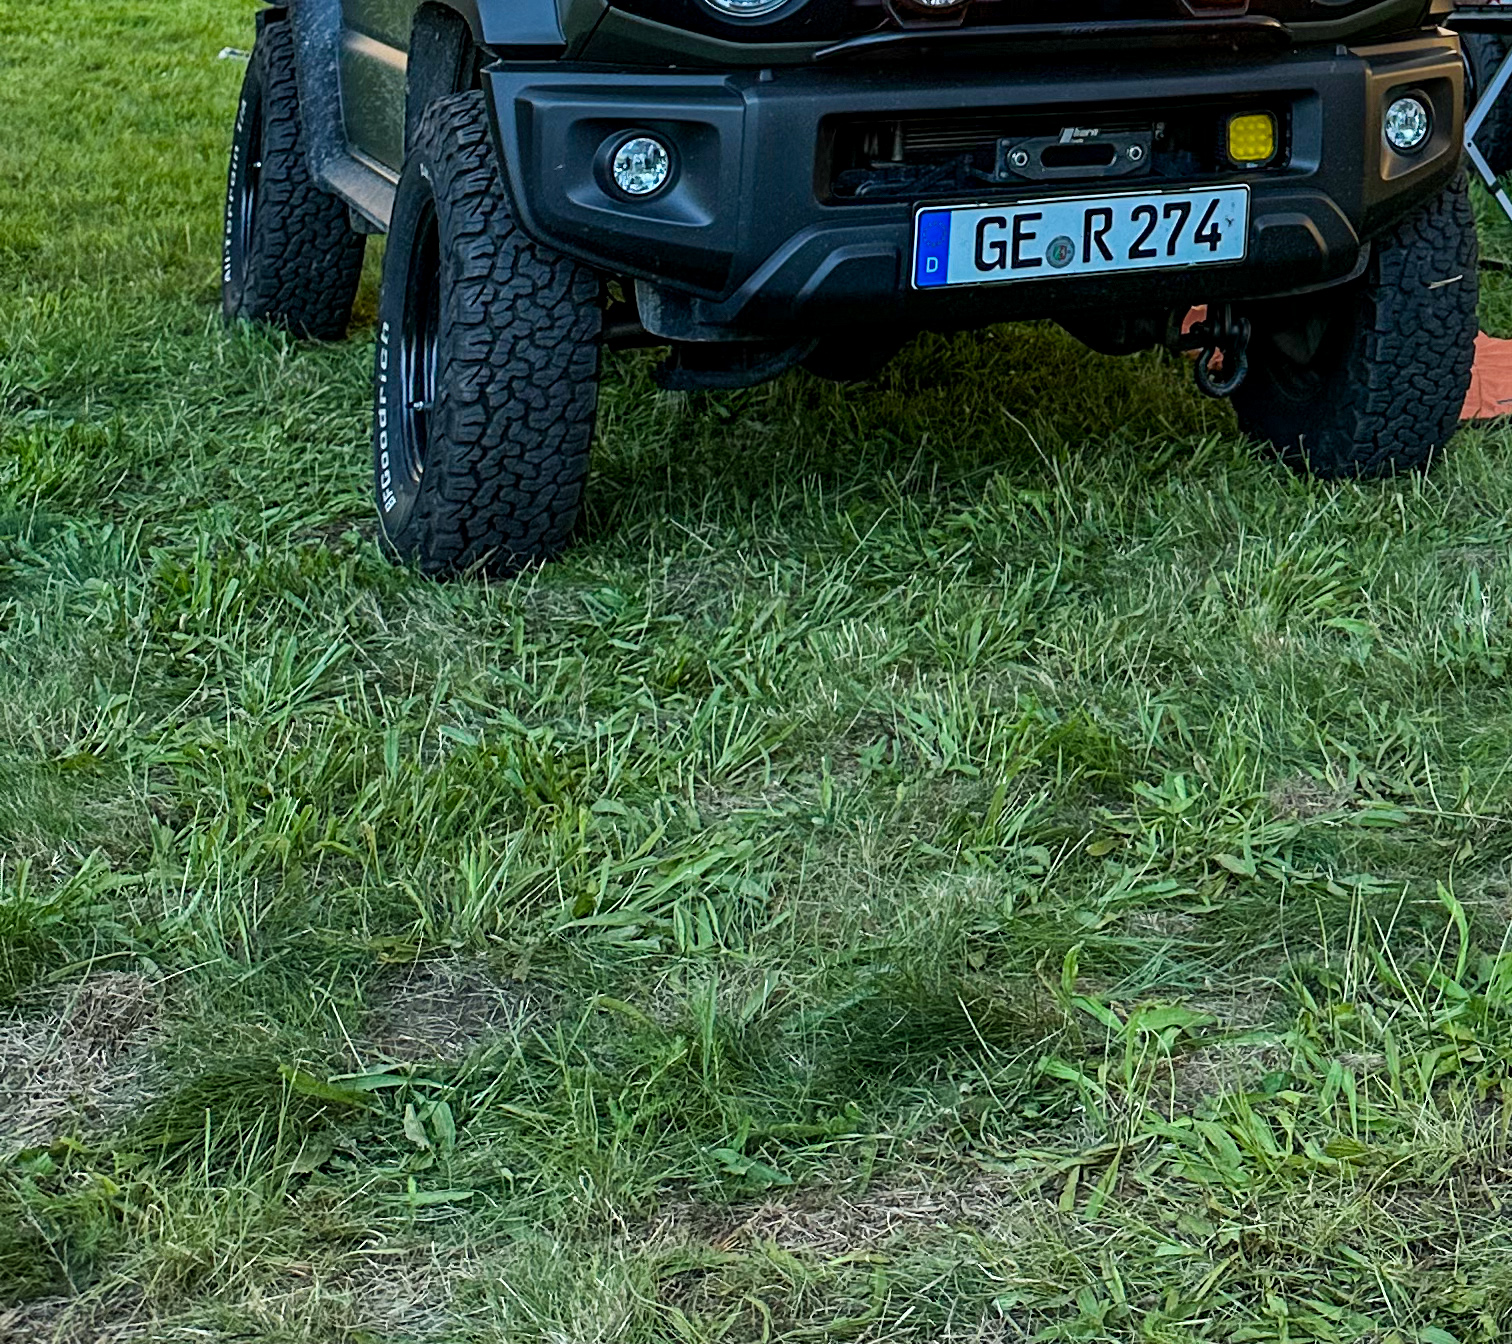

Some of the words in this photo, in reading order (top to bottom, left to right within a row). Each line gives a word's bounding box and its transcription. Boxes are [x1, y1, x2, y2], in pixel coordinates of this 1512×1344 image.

[925, 256, 939, 274] D
[974, 212, 1043, 272] GE
[1082, 207, 1114, 263] R
[1128, 198, 1222, 260] 274
[378, 320, 398, 513] BFGoodrich
